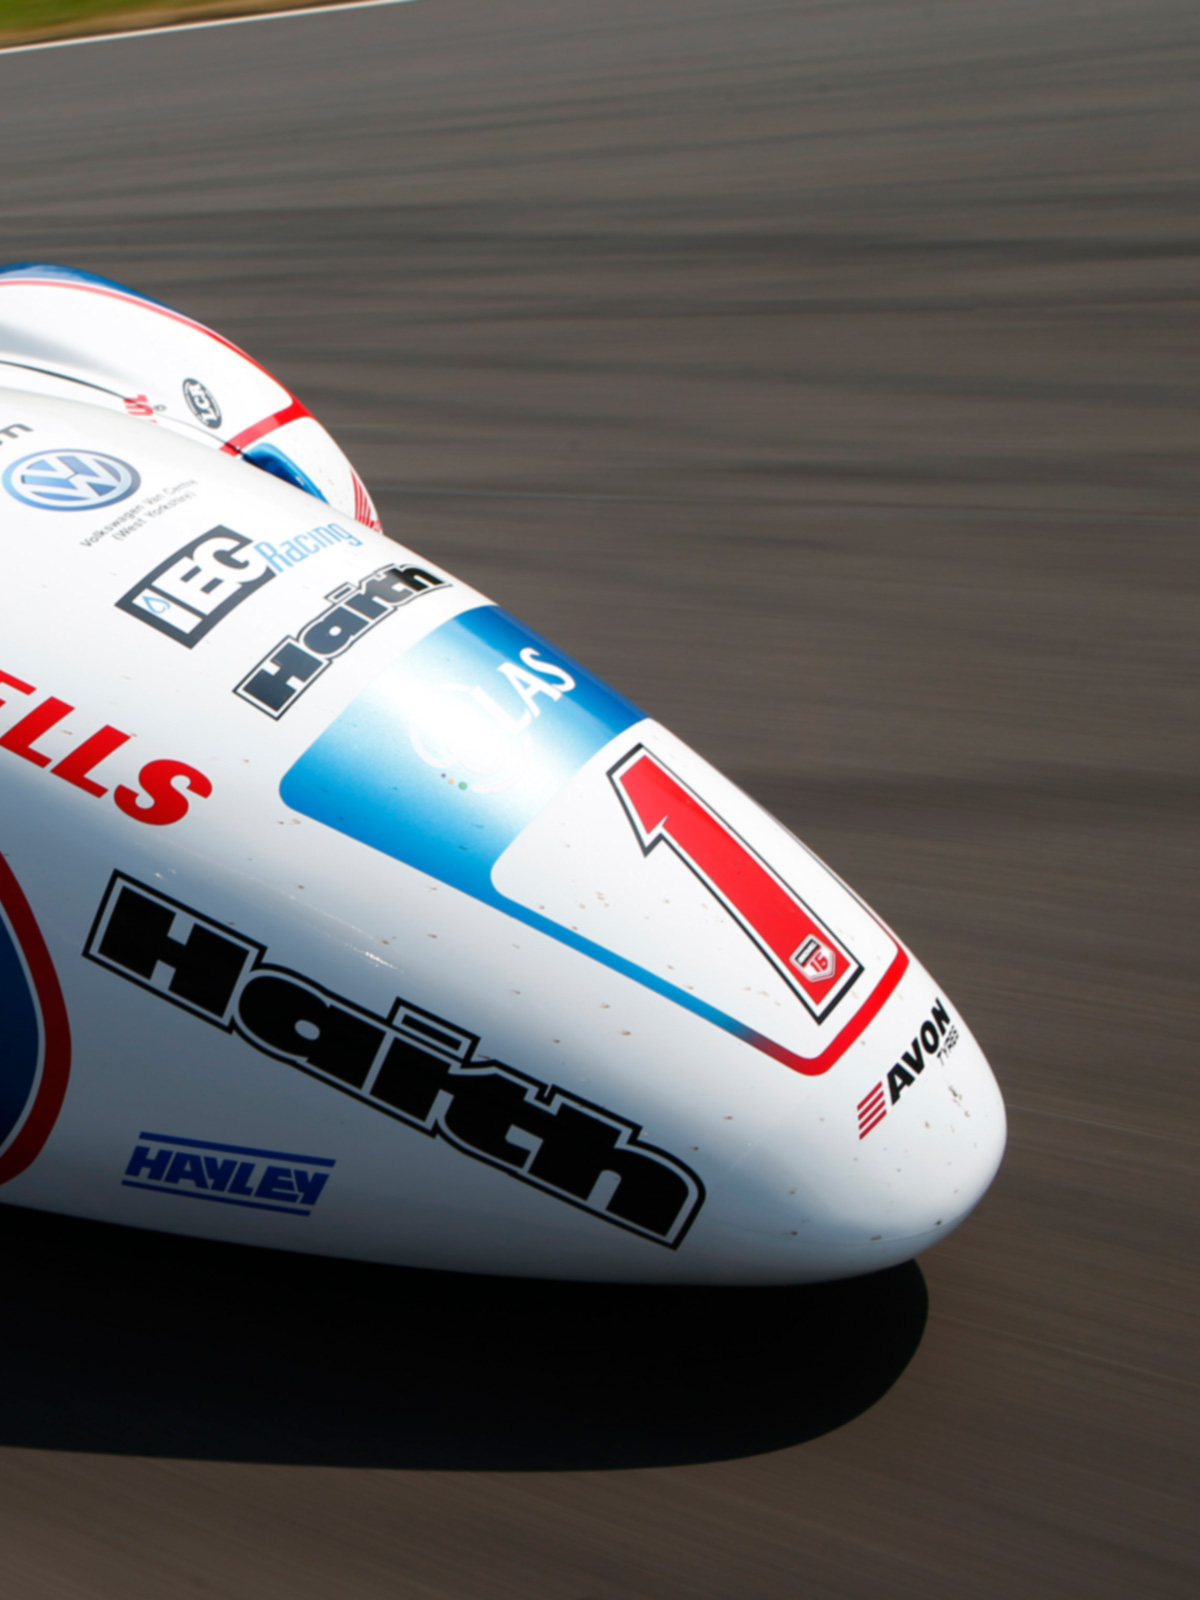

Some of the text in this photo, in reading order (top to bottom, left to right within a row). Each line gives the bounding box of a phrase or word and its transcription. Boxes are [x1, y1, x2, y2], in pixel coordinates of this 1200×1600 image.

[80, 503, 145, 548] Volkswagen
[142, 493, 165, 506] Van
[131, 522, 363, 636] IEG Racing
[232, 563, 454, 721] Haith
[82, 869, 706, 1250] Haith
[886, 998, 952, 1105] AVON
[936, 1025, 960, 1067] TYRES
[124, 1144, 333, 1207] HAYLEY
